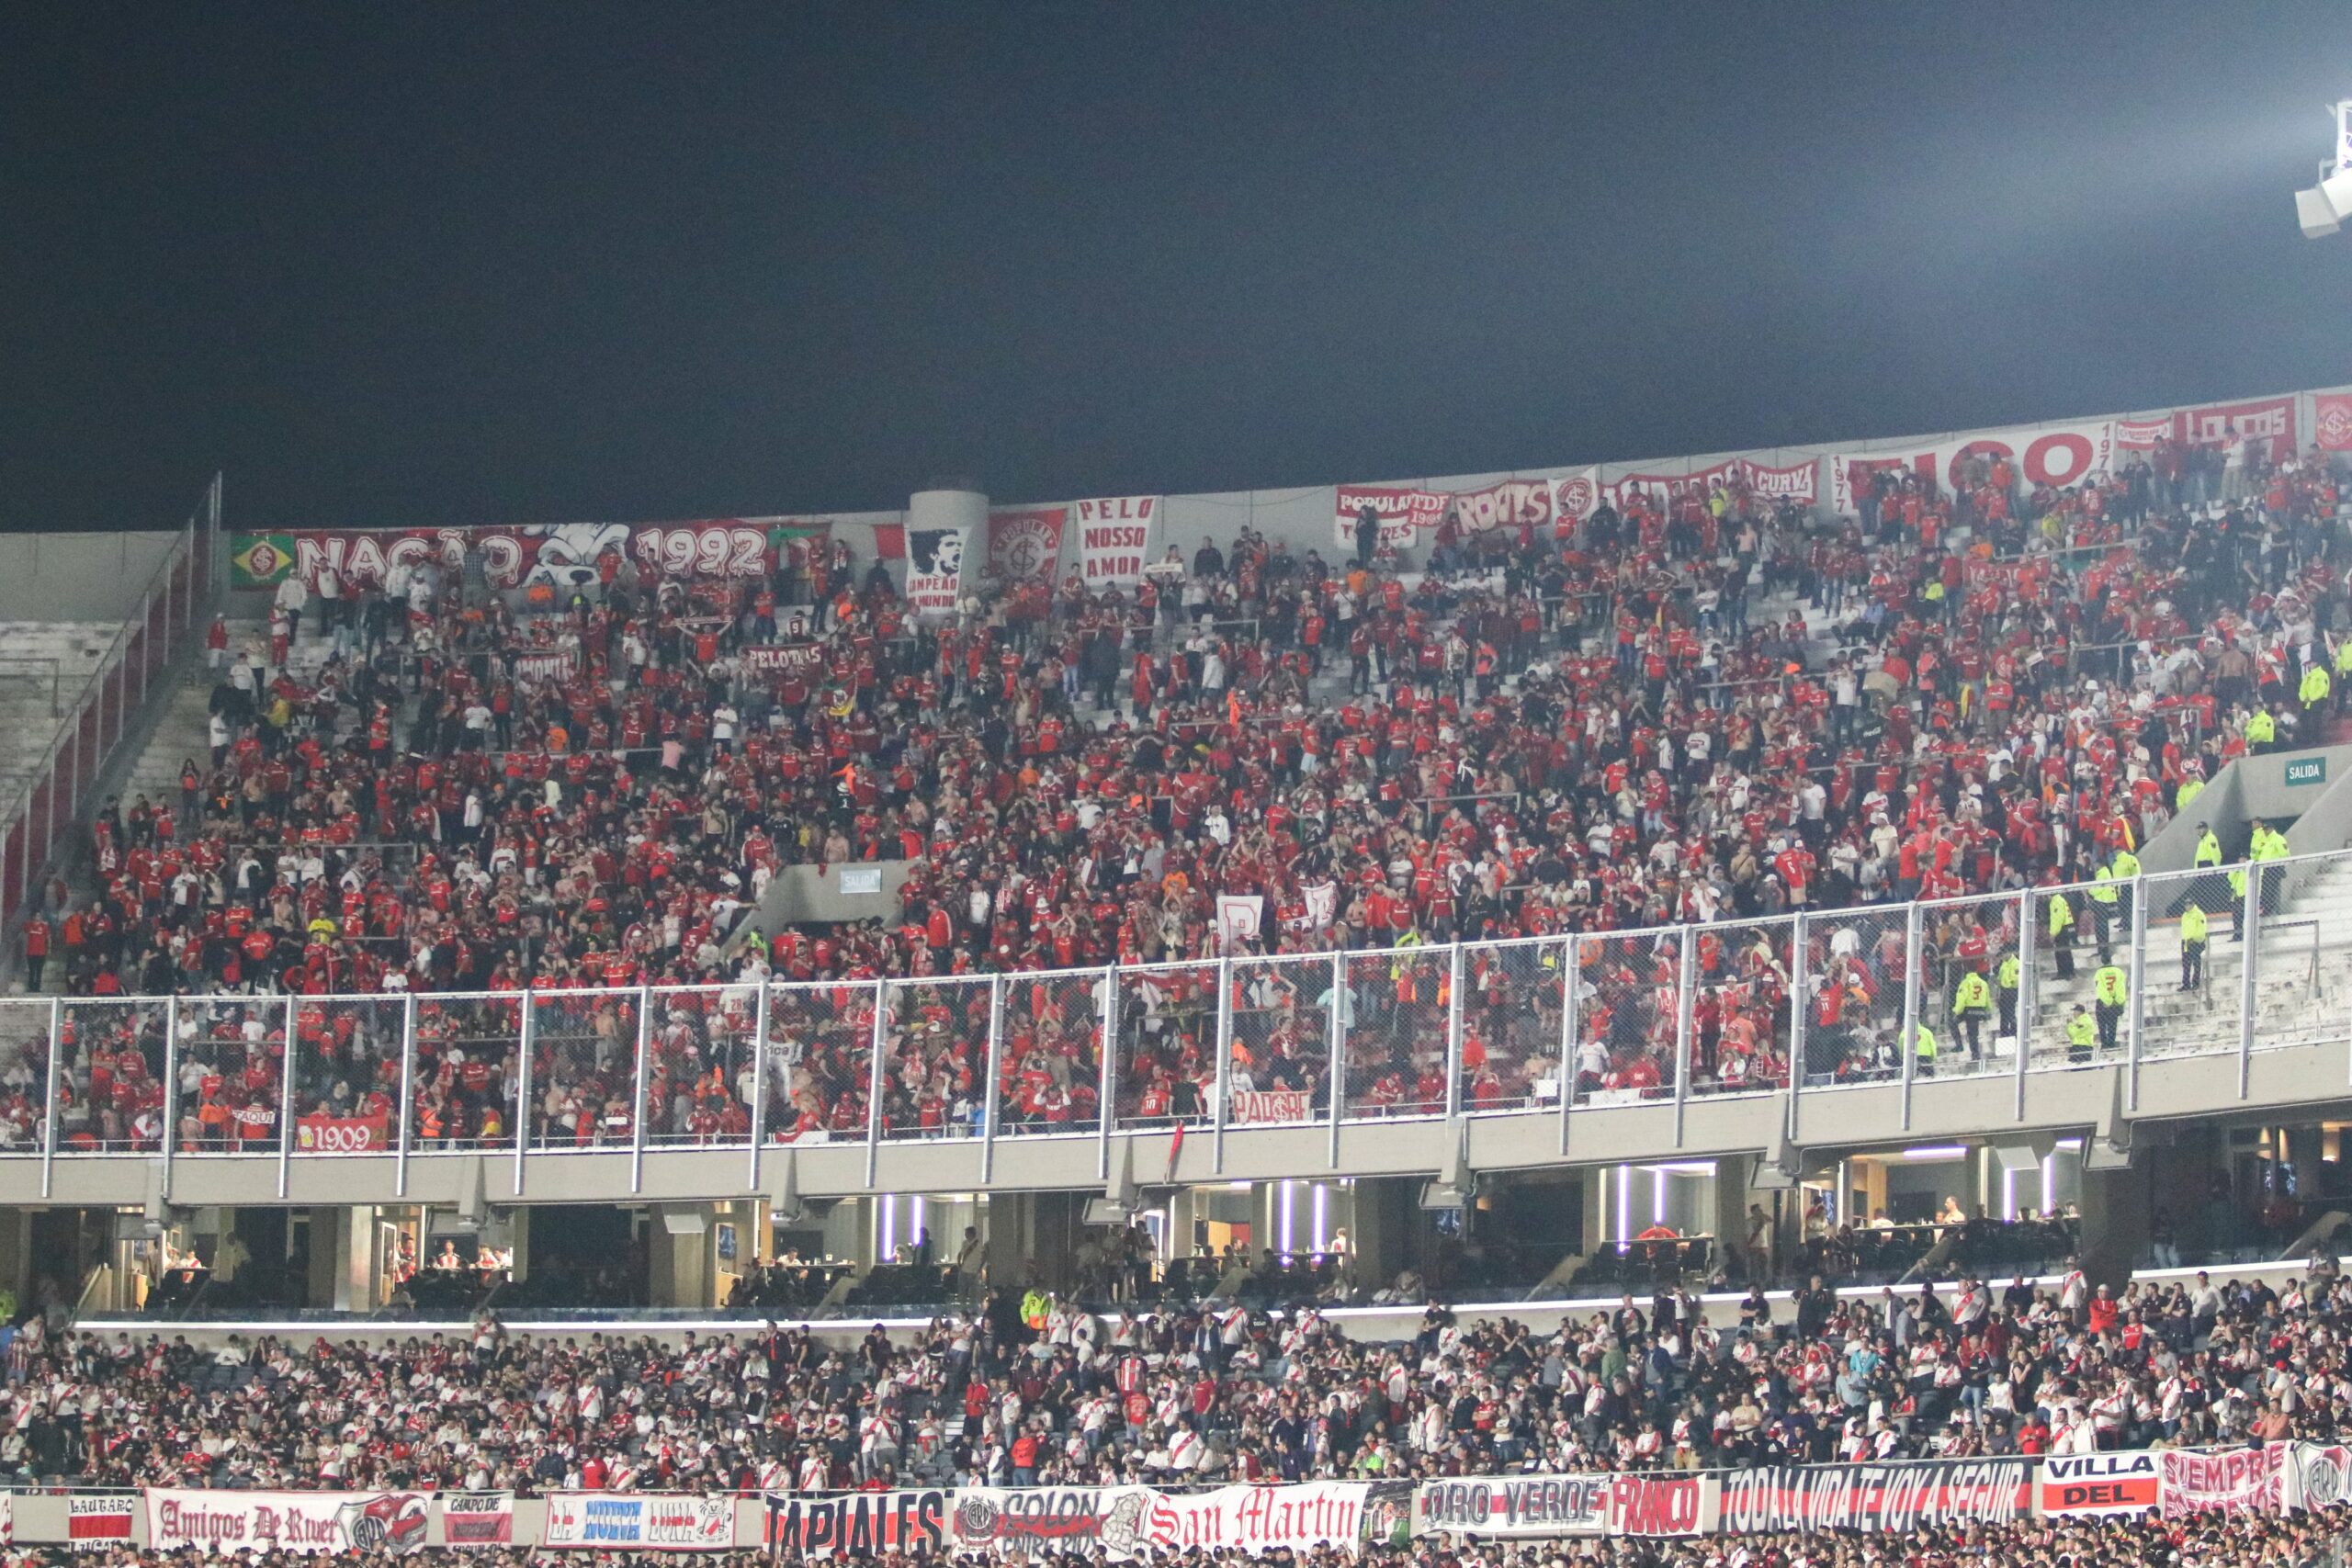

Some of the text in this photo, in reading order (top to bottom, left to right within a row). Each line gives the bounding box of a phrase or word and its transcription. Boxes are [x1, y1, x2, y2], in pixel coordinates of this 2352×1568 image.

[1758, 464, 1813, 497] CURVA
[1079, 499, 1154, 521] PELO
[1085, 526, 1146, 549] NOSSO
[1341, 524, 1412, 540] TRES
[636, 528, 766, 578] 1992
[1087, 557, 1140, 578] AMOR
[2289, 764, 2320, 780] SALIDA
[844, 874, 876, 887] SALIDA
[315, 1124, 370, 1150] 1909
[2048, 1455, 2155, 1478] VILLA
[2164, 1442, 2286, 1493] SIEMPRE
[70, 1498, 134, 1514] LAUTARO
[485, 1496, 501, 1511] DE
[1425, 1479, 1600, 1526] ORO VERDE
[1612, 1476, 1699, 1533] FRANCO
[1726, 1467, 1780, 1532] TODA
[1782, 1466, 1804, 1530] LA
[1807, 1468, 1852, 1531] VIDA
[1859, 1468, 1882, 1530] TE
[1883, 1467, 1924, 1530] VOY
[1942, 1462, 2024, 1526] SEGUIR
[2064, 1484, 2135, 1505] DEL
[160, 1499, 247, 1546] Amigos
[254, 1506, 282, 1541] De
[765, 1491, 944, 1555] TAPIALES
[1003, 1491, 1102, 1529] COLON
[1149, 1495, 1222, 1546] San
